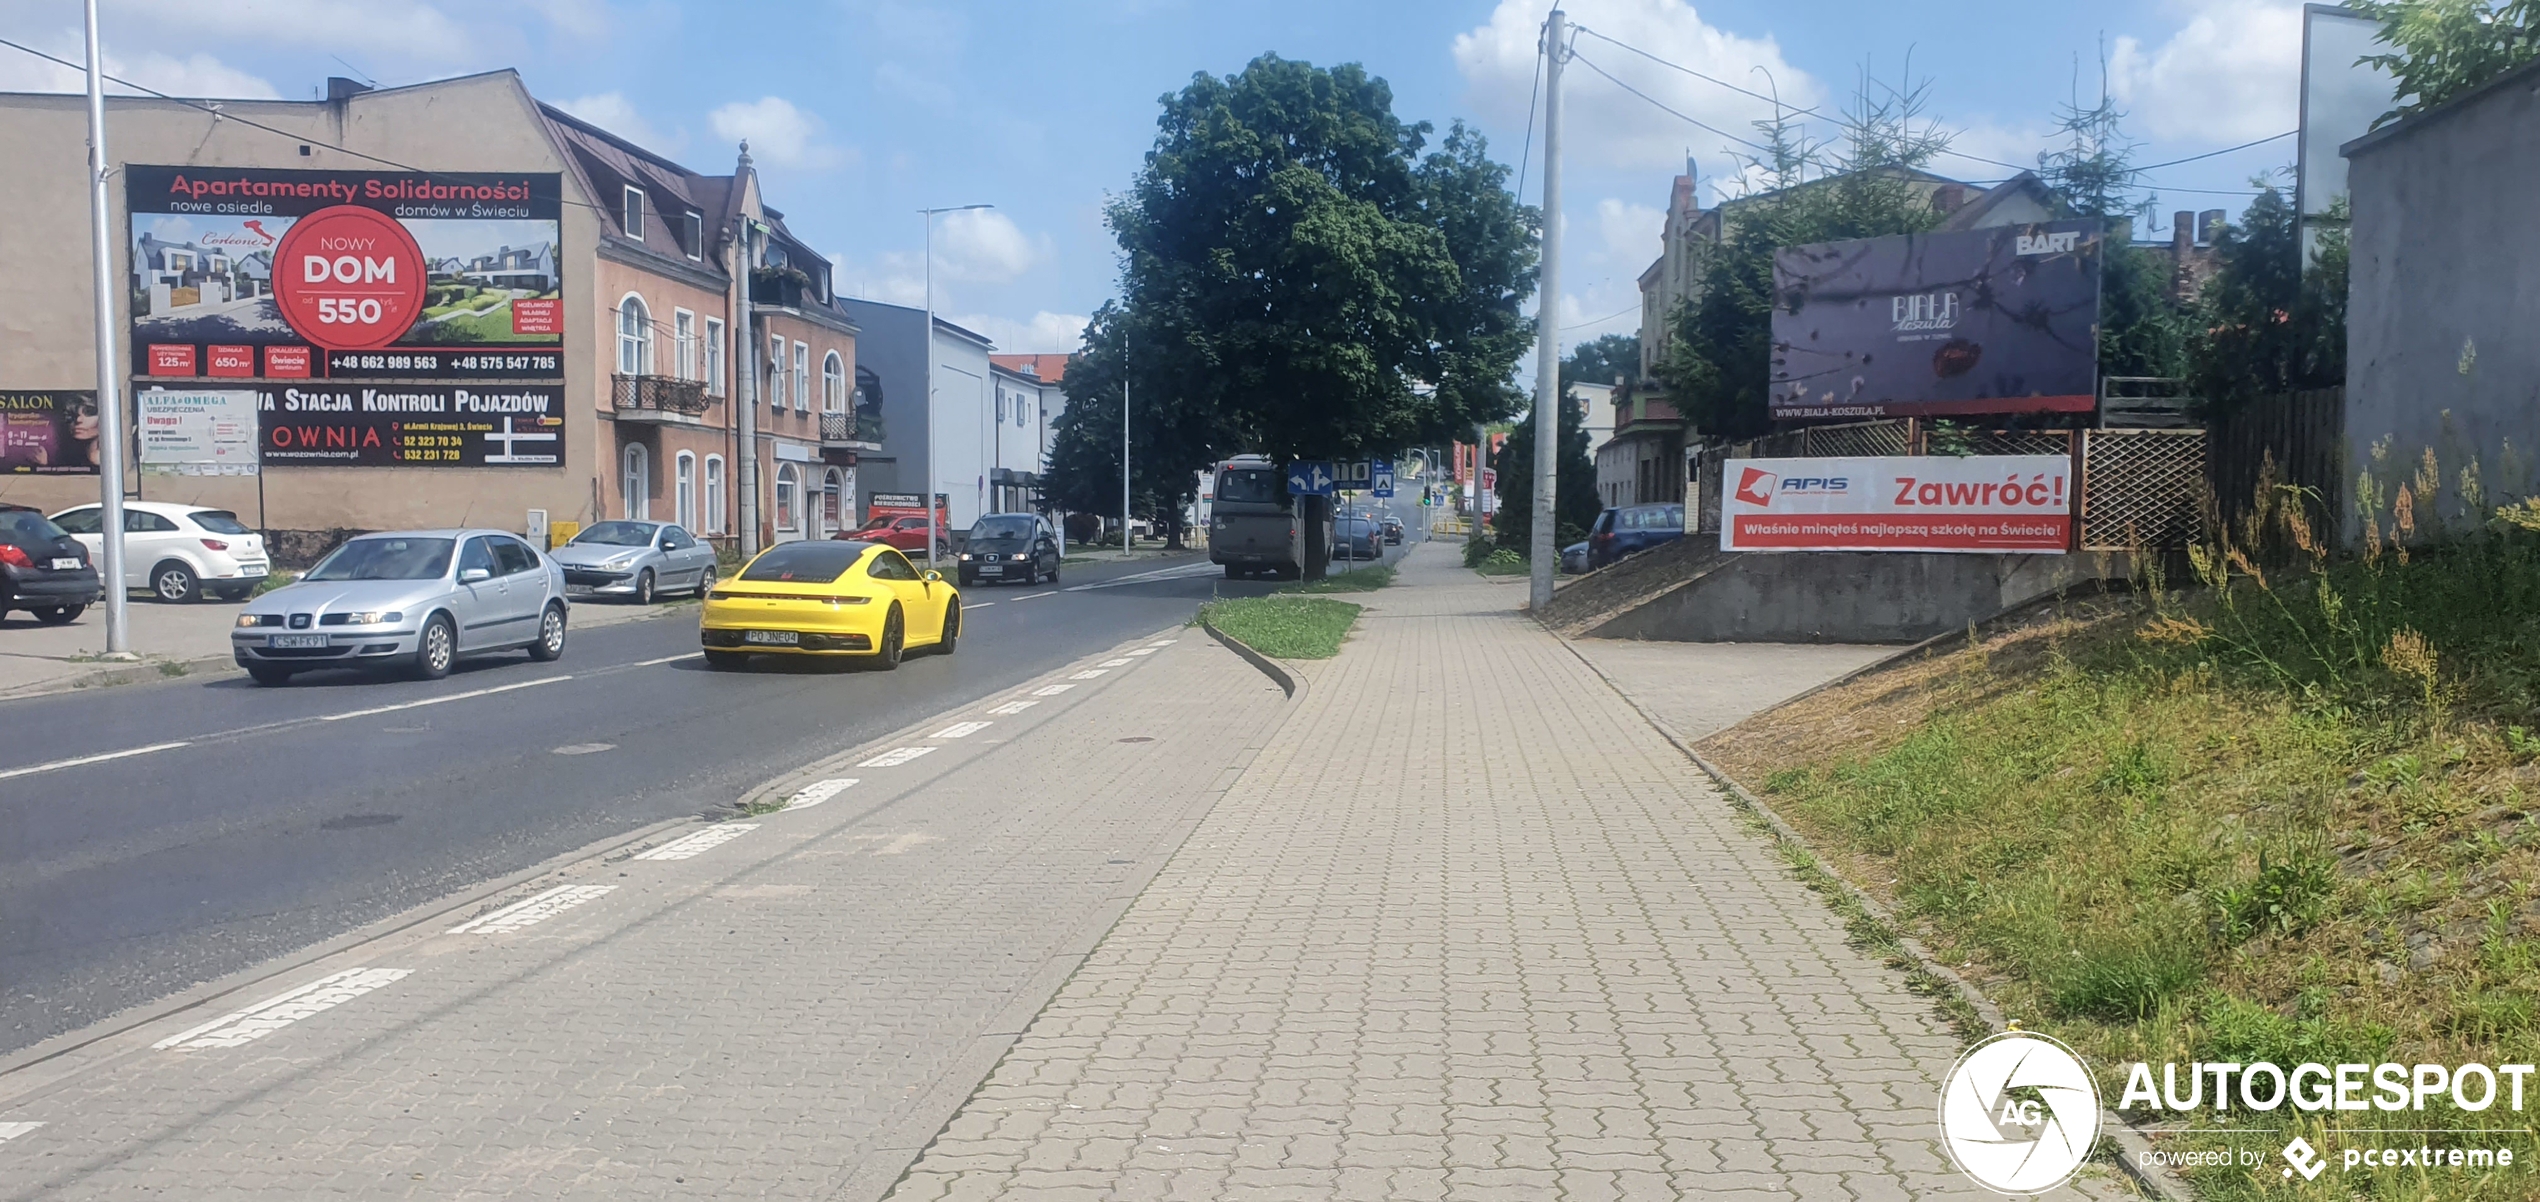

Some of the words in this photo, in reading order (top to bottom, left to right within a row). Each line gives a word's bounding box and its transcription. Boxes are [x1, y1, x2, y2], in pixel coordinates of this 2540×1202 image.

[170, 174, 358, 203] Apartamenty
[364, 179, 529, 200] Solidarności
[170, 201, 212, 212] nowe
[216, 201, 273, 214] osiedle
[394, 203, 450, 217] domów
[455, 208, 467, 216] w
[471, 202, 529, 217] Świeciu
[321, 237, 375, 250] NOWY
[2016, 231, 2080, 256] BART
[303, 255, 395, 284] DOM
[318, 298, 382, 324] 550
[1893, 292, 1959, 322] BIAŁA
[158, 357, 179, 367] 125
[215, 357, 238, 368] 650
[271, 354, 305, 365] Świecie
[331, 355, 358, 369] +48
[361, 356, 384, 369] 662
[387, 356, 411, 369] 989
[414, 356, 437, 369] 563
[451, 356, 477, 370] +48
[480, 356, 503, 370] 575
[506, 356, 530, 370] 547
[532, 356, 555, 370] 785
[0, 395, 54, 409] SALON
[184, 396, 227, 405] OMEGA
[1776, 401, 1885, 417] WWW.BIALA-KOSZULA.PL
[260, 425, 381, 448] OWNIA
[418, 436, 435, 447] 323
[437, 436, 449, 447] 70
[404, 449, 422, 460] 532
[424, 449, 440, 460] 231
[1781, 478, 1849, 490] APIS
[1894, 473, 2064, 507] Zawróć!
[1744, 523, 1800, 535] Właśnie
[1802, 523, 1858, 537] minąłeś
[1860, 523, 1928, 537] najlepszą
[1931, 524, 1976, 537] szkołę
[1979, 528, 1998, 536] na
[2000, 522, 2061, 536] Świecie!
